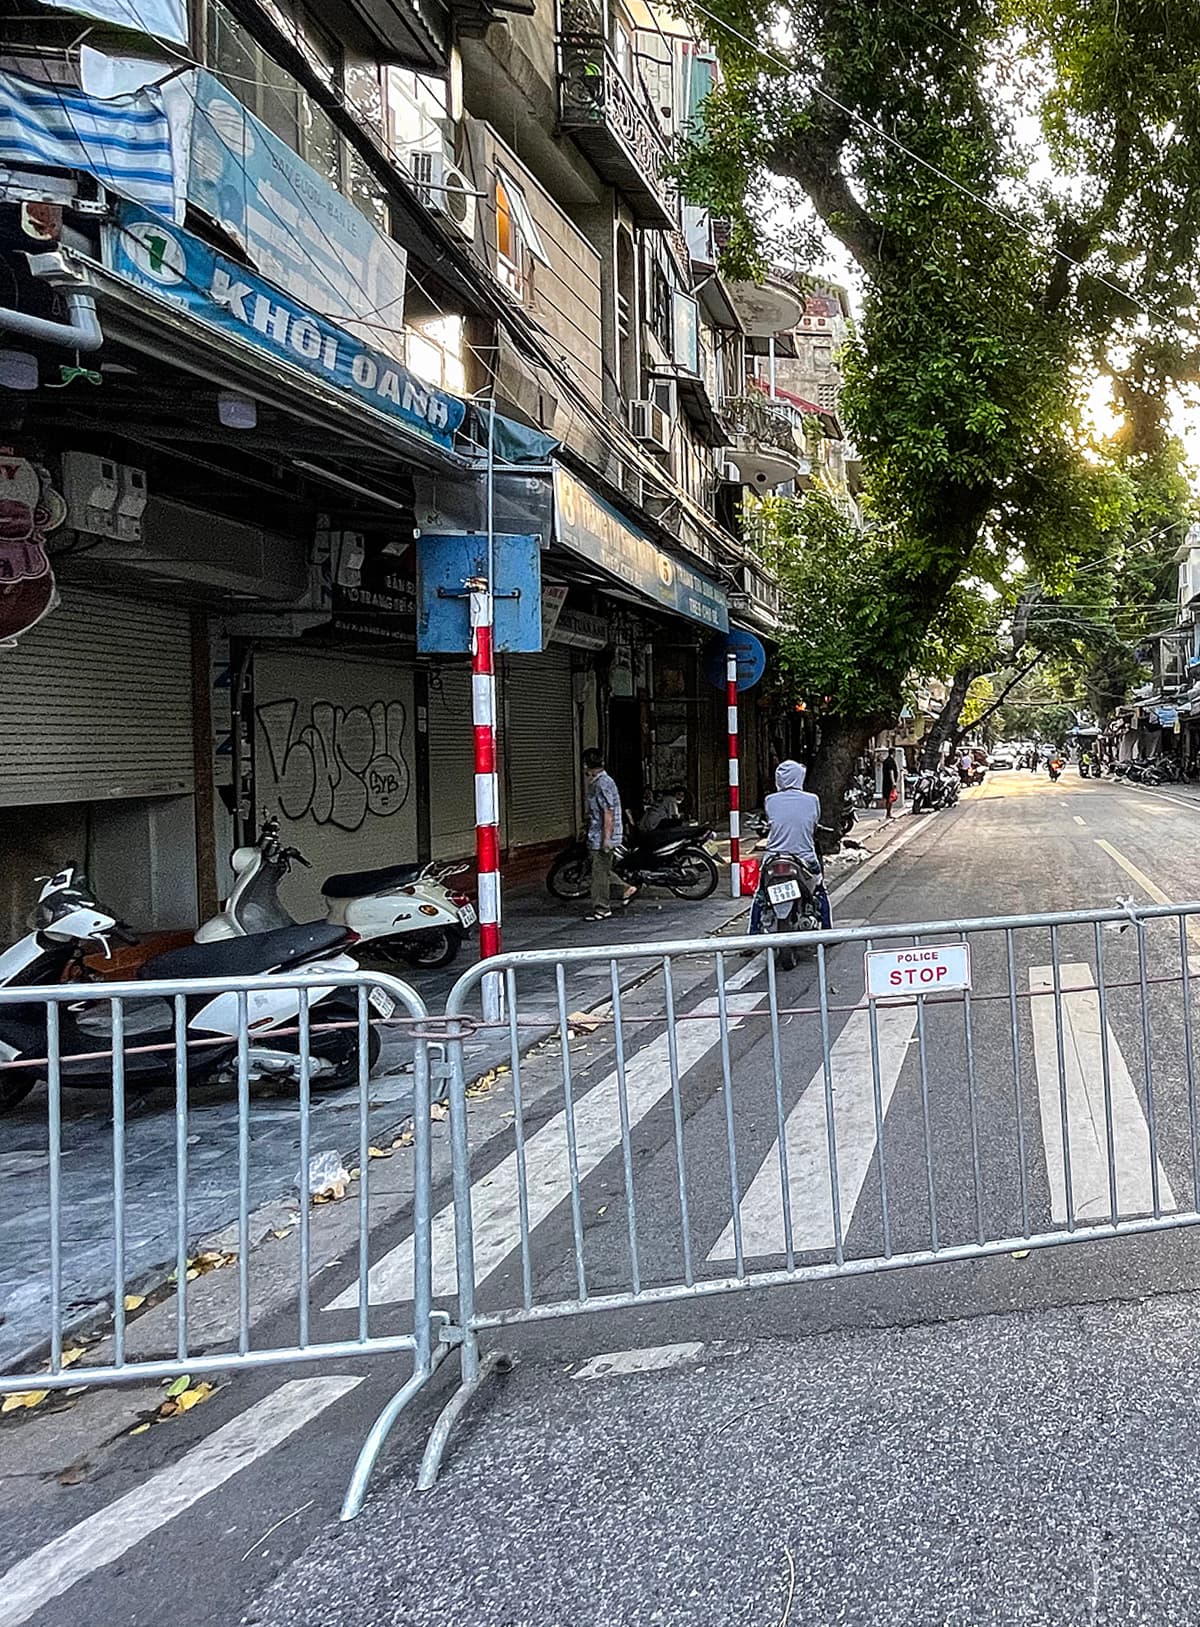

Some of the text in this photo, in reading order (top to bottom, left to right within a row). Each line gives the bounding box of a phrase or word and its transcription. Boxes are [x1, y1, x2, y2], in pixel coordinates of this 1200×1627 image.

[210, 268, 448, 428] KHÔI OANH
[897, 952, 938, 963] POLICE
[890, 967, 947, 985] STOP
